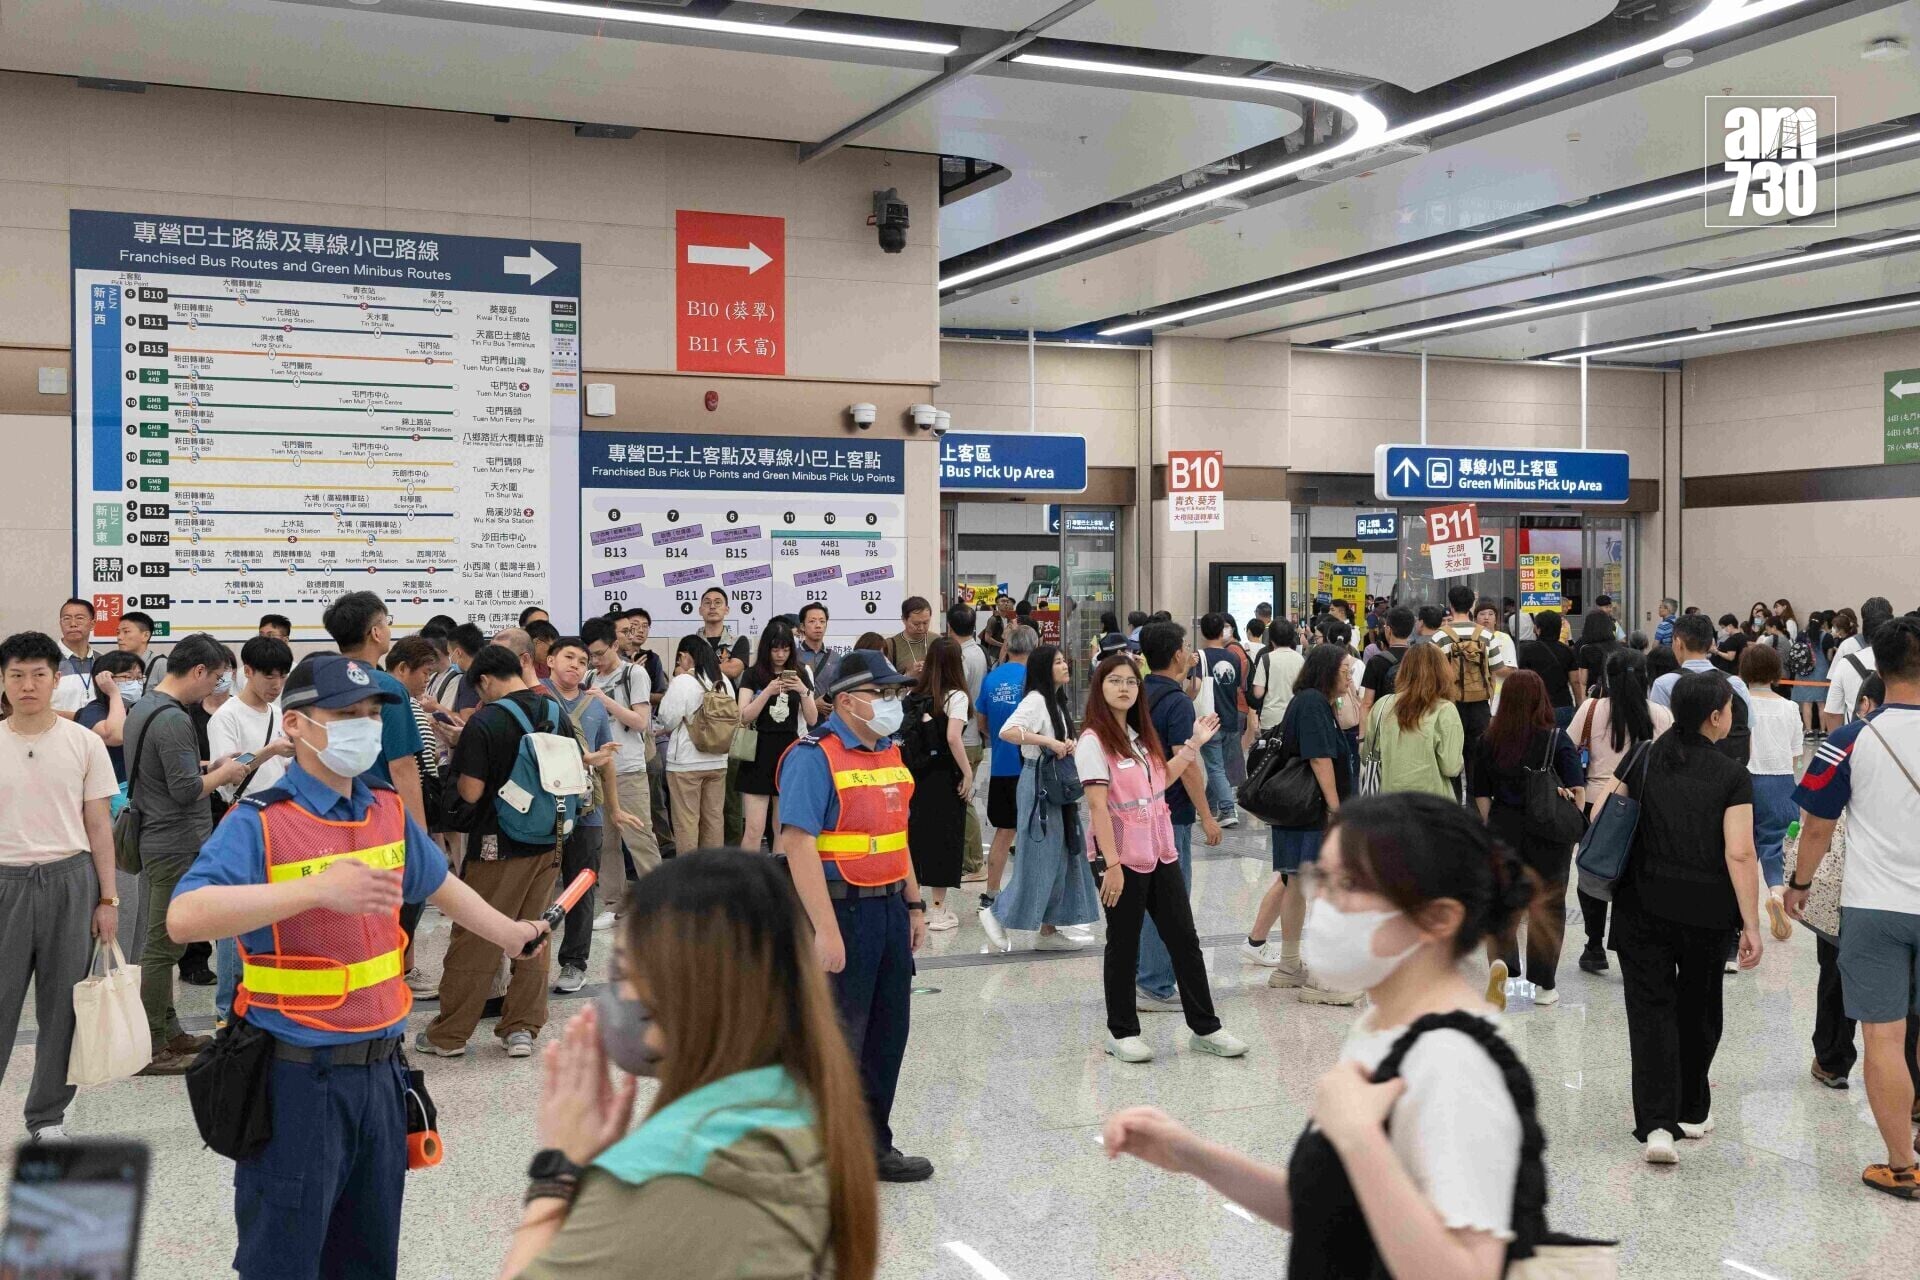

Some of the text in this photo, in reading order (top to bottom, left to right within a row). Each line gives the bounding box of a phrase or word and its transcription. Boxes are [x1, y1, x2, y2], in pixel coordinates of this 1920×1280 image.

[133, 221, 440, 262] 專營巴士路線及專線小巴路線
[120, 250, 452, 281] Franchised Bus Routes and Green Minibus Routes
[108, 286, 119, 309] NTW
[143, 290, 164, 299] B10
[93, 285, 106, 326] 新界西
[687, 300, 719, 317] B10
[143, 317, 164, 326] B11
[143, 344, 164, 354] B15
[688, 336, 720, 352] B11
[490, 381, 518, 391] 屯門站
[476, 390, 493, 398] Tuen
[510, 391, 532, 399] Station
[607, 443, 881, 470] 專營巴士上客點及專線小巴上客點
[941, 443, 992, 463] 上客區
[946, 465, 971, 478] Bus
[974, 464, 1001, 478] Pick
[1003, 466, 1022, 482] Up
[1024, 466, 1055, 479] Area
[1171, 456, 1220, 489] B10
[1458, 458, 1559, 477] 專線小巴上客區
[592, 466, 896, 485] Franchised Bus Pick Up Points and Green Minibus Pick Up Points
[490, 482, 518, 492] 天水圍
[1458, 477, 1602, 494] Green Minibus Pick Up Area
[110, 505, 119, 525] NTE
[144, 506, 165, 516] B12
[94, 505, 108, 543] 新界東
[1387, 518, 1395, 534] 3
[1430, 508, 1474, 542] B11
[141, 534, 169, 543] NB73
[481, 532, 527, 542] 沙田市中心
[604, 547, 628, 558] B13
[665, 547, 688, 558] B14
[725, 548, 748, 558] B15
[1447, 543, 1465, 555] 元朗
[94, 558, 122, 572] 港島
[1521, 557, 1534, 565] B13
[145, 565, 166, 575] B13
[1521, 570, 1534, 578] B14
[96, 571, 120, 582] HKI
[1343, 578, 1357, 586] B13
[1521, 582, 1535, 590] B15
[604, 590, 628, 601] B10
[676, 590, 698, 601] B11
[731, 590, 762, 601] NB73
[806, 590, 828, 601] B12
[861, 590, 882, 601] B12
[145, 597, 166, 606] B14
[96, 597, 109, 621] 九龍
[111, 597, 120, 618] KLN
